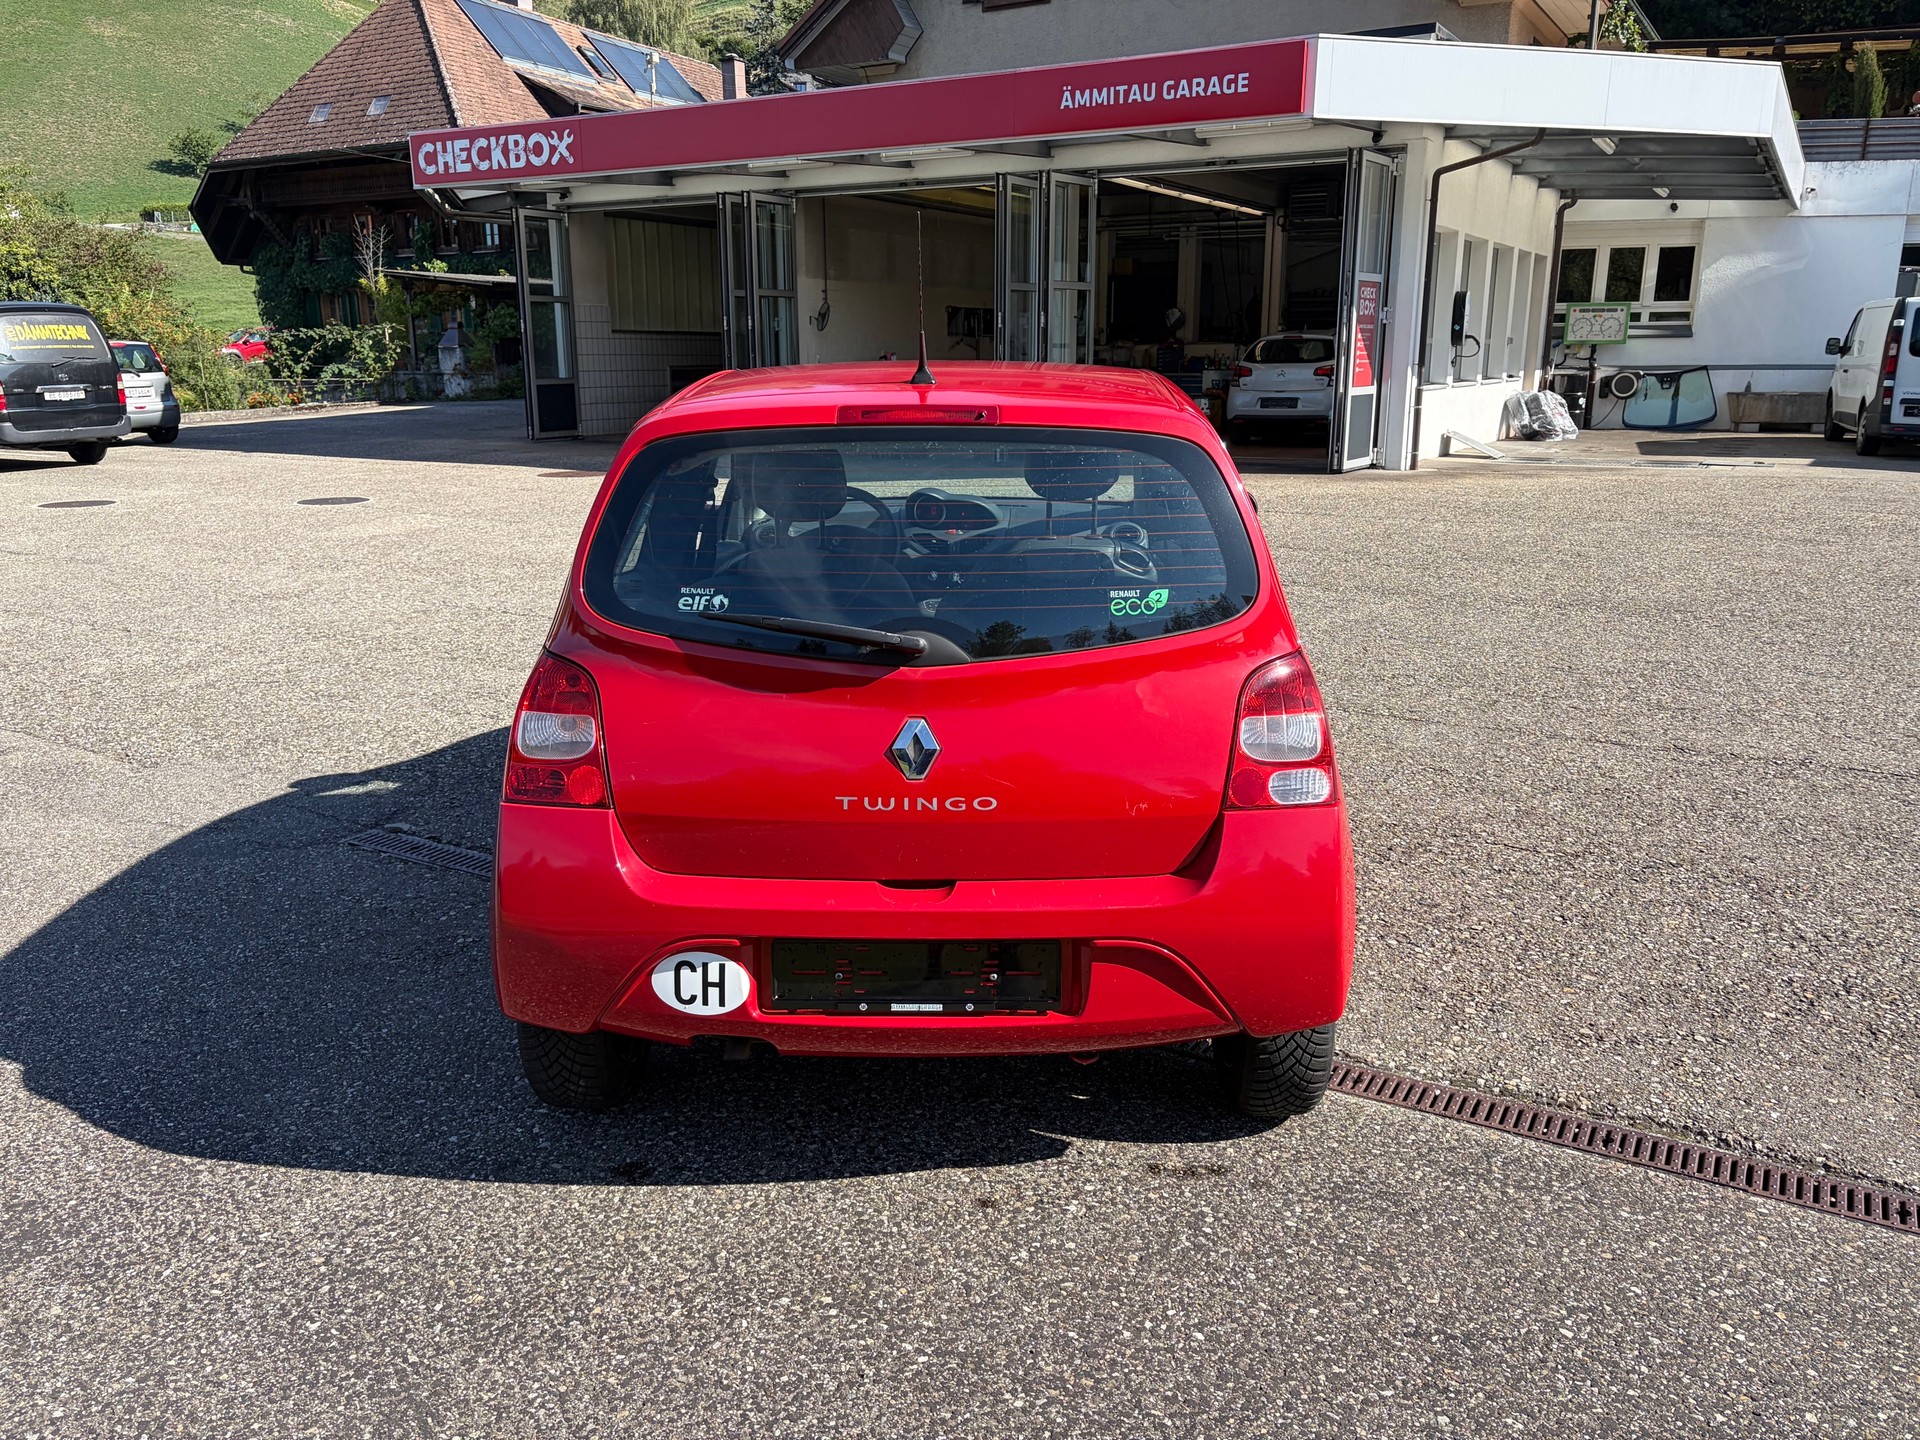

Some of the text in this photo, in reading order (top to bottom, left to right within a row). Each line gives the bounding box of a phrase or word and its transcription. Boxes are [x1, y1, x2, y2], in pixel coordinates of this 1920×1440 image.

[1060, 73, 1250, 109] ÄMMITAU GARAGE
[418, 129, 574, 175] CHECKBOX
[1360, 287, 1377, 299] CHECK
[1359, 300, 1375, 316] BOX
[680, 587, 715, 595] RENAULT
[1110, 589, 1140, 598] RENAULT
[678, 595, 711, 611] elf
[835, 796, 998, 811] TWINGO
[674, 960, 726, 1008] CH
